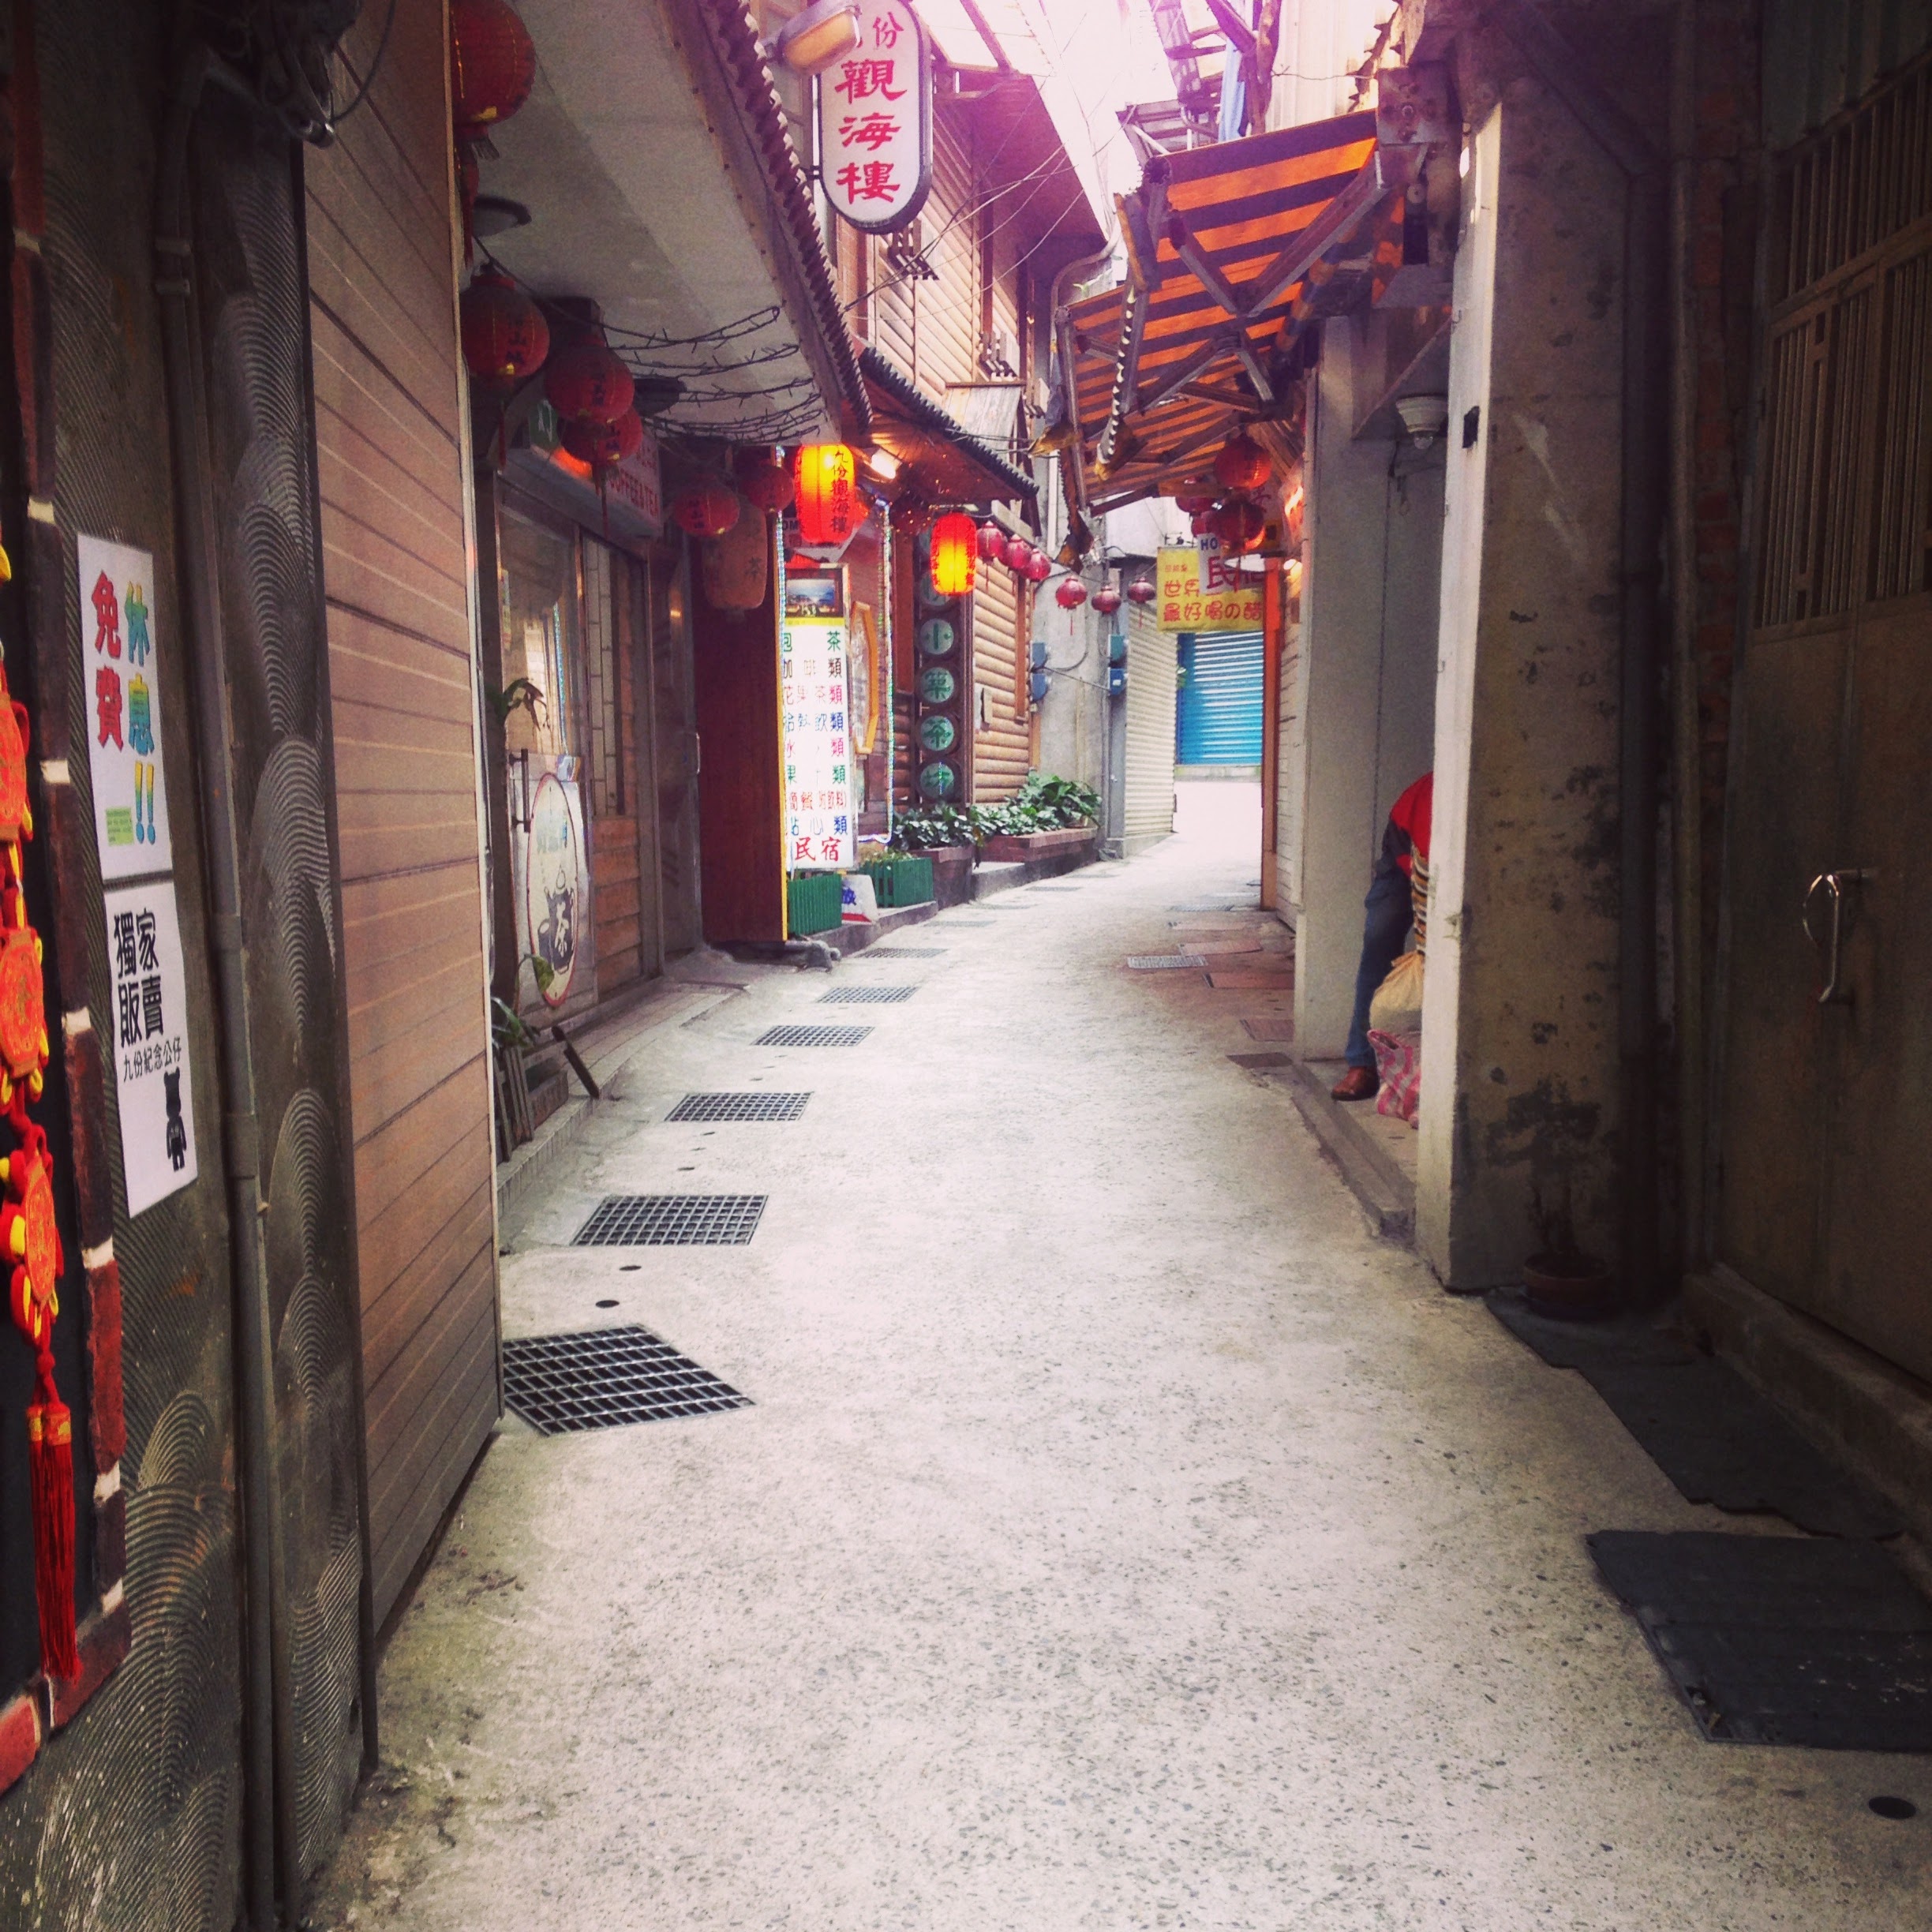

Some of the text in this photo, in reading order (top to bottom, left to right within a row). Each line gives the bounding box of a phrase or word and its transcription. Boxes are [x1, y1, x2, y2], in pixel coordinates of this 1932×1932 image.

[833, 58, 908, 205] 觀海樓
[1200, 537, 1219, 551] HO
[91, 568, 125, 754] 免費
[795, 836, 842, 863] 民宿
[113, 908, 159, 979] 獨家
[118, 974, 164, 1049] 販賣
[123, 1035, 182, 1083] 九份紀念公仔
